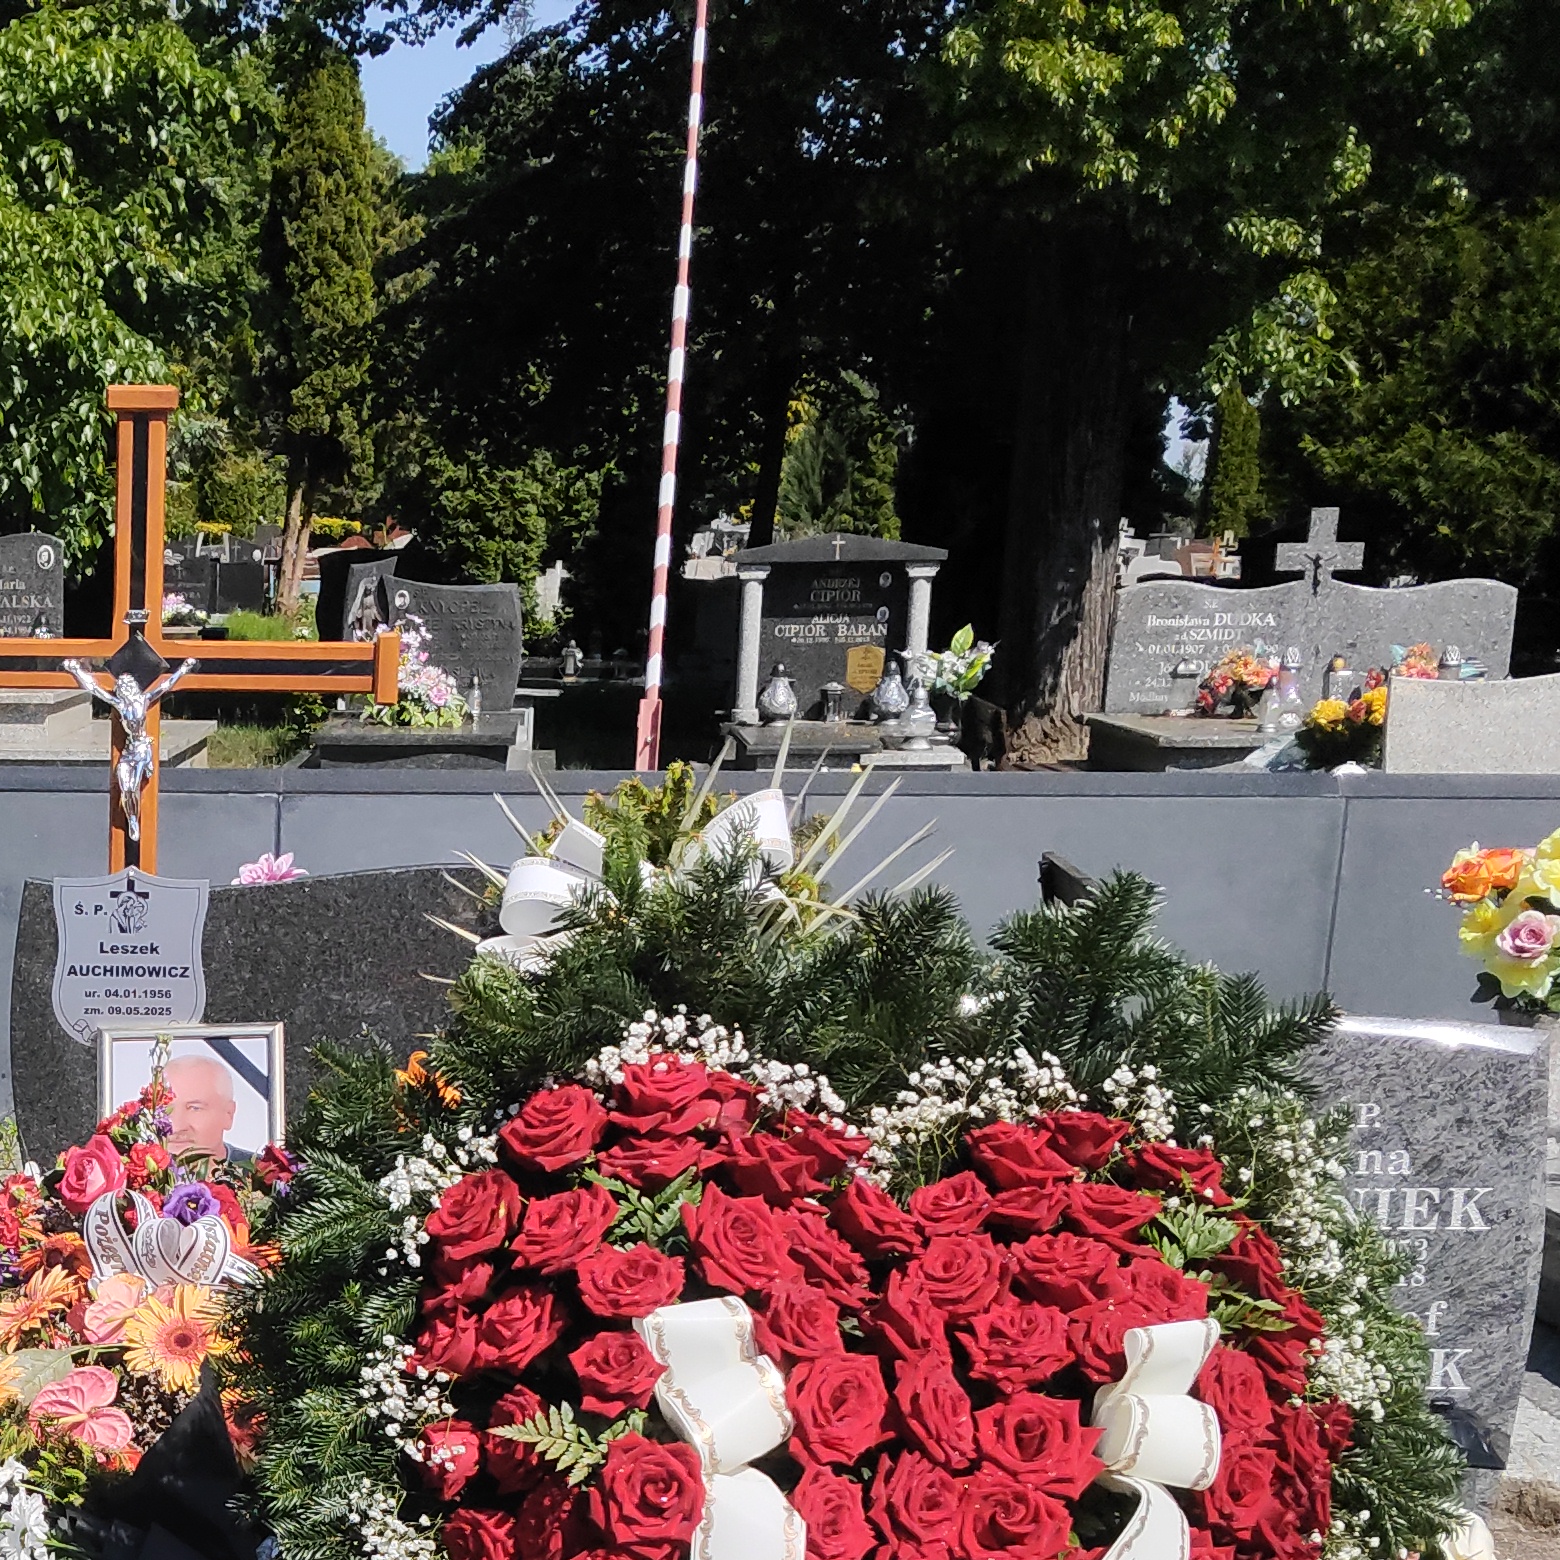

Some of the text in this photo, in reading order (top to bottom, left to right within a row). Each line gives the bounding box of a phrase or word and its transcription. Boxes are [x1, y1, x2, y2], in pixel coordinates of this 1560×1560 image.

[812, 614, 850, 624] ALICJA
[1213, 612, 1276, 626] DUDKA
[837, 624, 888, 636] BARAN
[94, 905, 108, 915] P.
[99, 941, 160, 955] Leszek
[66, 965, 190, 978] AUCHIMOWICZ
[84, 989, 172, 999] ur. 04.01.1956
[83, 1006, 172, 1016] zm. 09.05.2025
